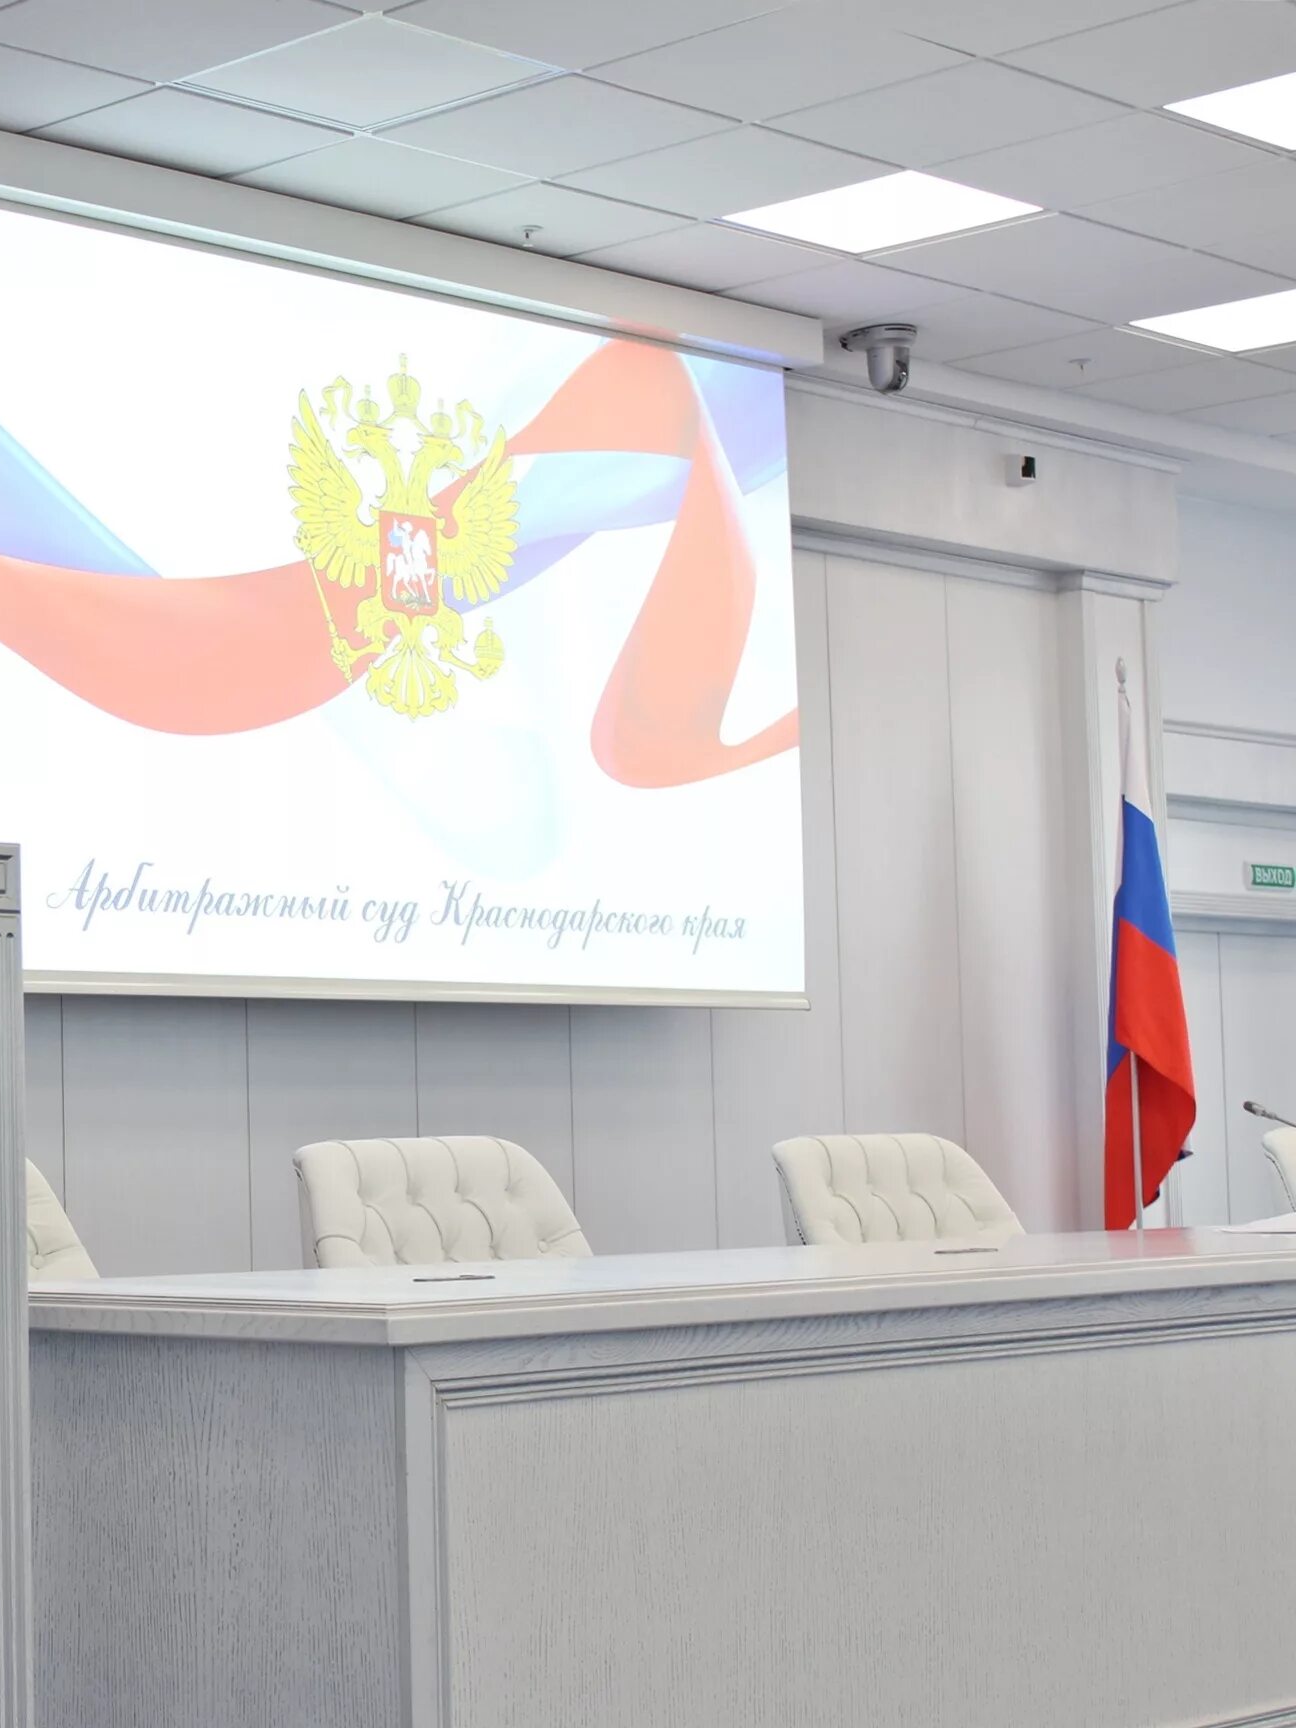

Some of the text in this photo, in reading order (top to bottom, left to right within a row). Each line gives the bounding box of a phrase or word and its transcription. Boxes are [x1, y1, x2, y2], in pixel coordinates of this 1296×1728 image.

[1255, 867, 1292, 885] ВЫХОД
[46, 857, 747, 955] Арбитражный суд Краснодарского края
